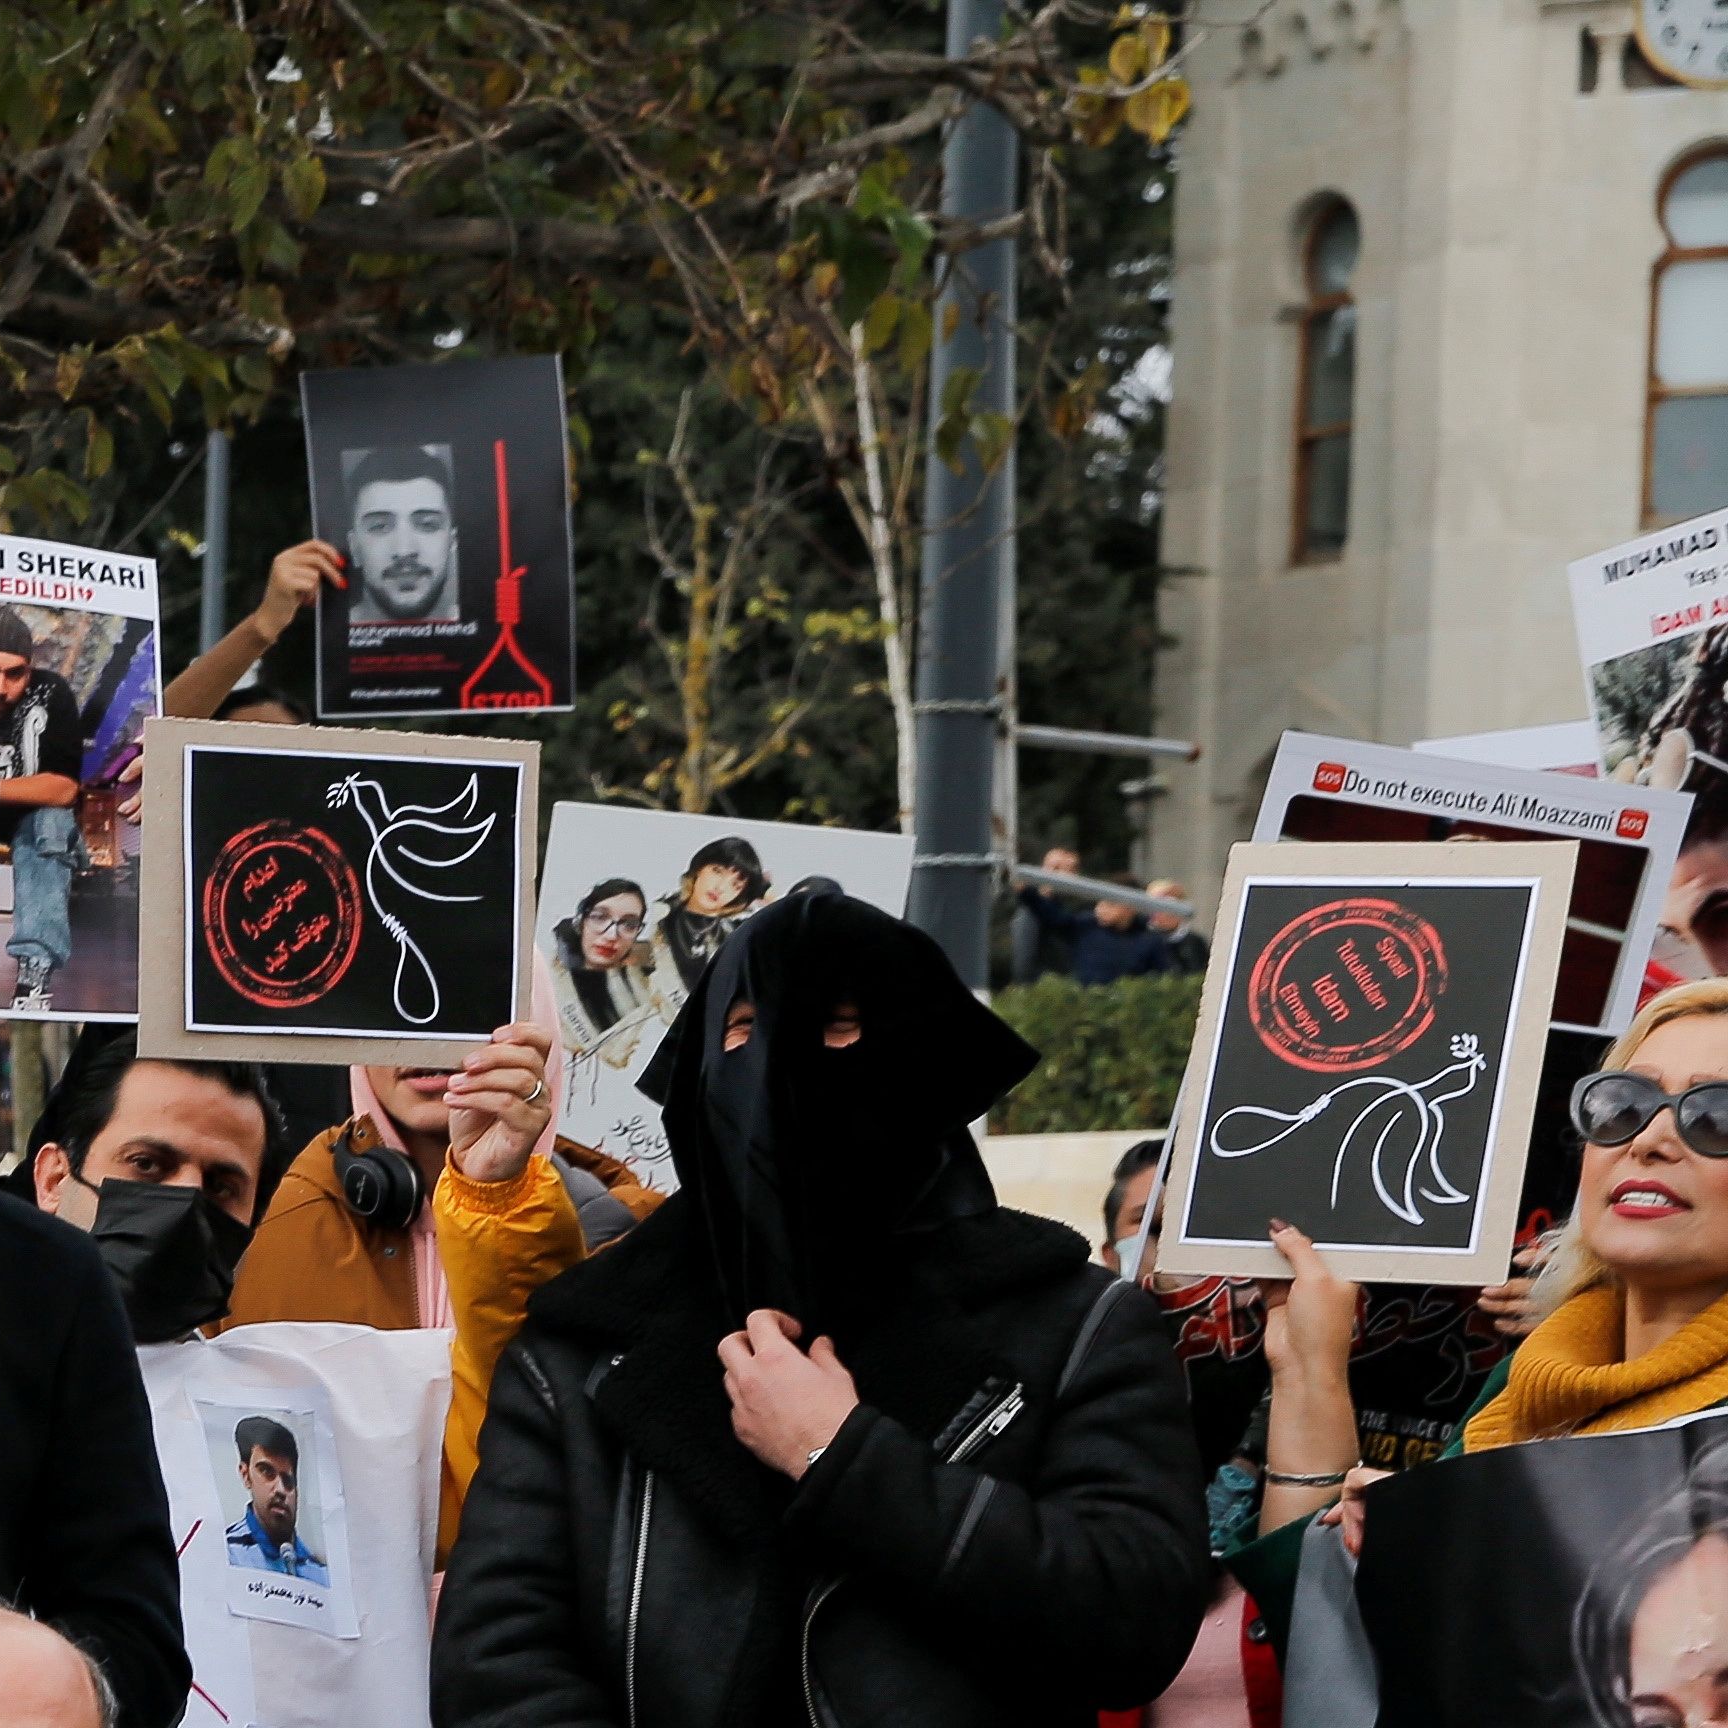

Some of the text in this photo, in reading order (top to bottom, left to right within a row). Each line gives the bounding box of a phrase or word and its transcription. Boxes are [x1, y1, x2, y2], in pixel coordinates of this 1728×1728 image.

[1343, 770, 1369, 794] Do
[1375, 780, 1407, 801] not
[1411, 787, 1487, 813] execute
[1491, 793, 1517, 817] Ali
[1520, 798, 1616, 832] Moazzami
